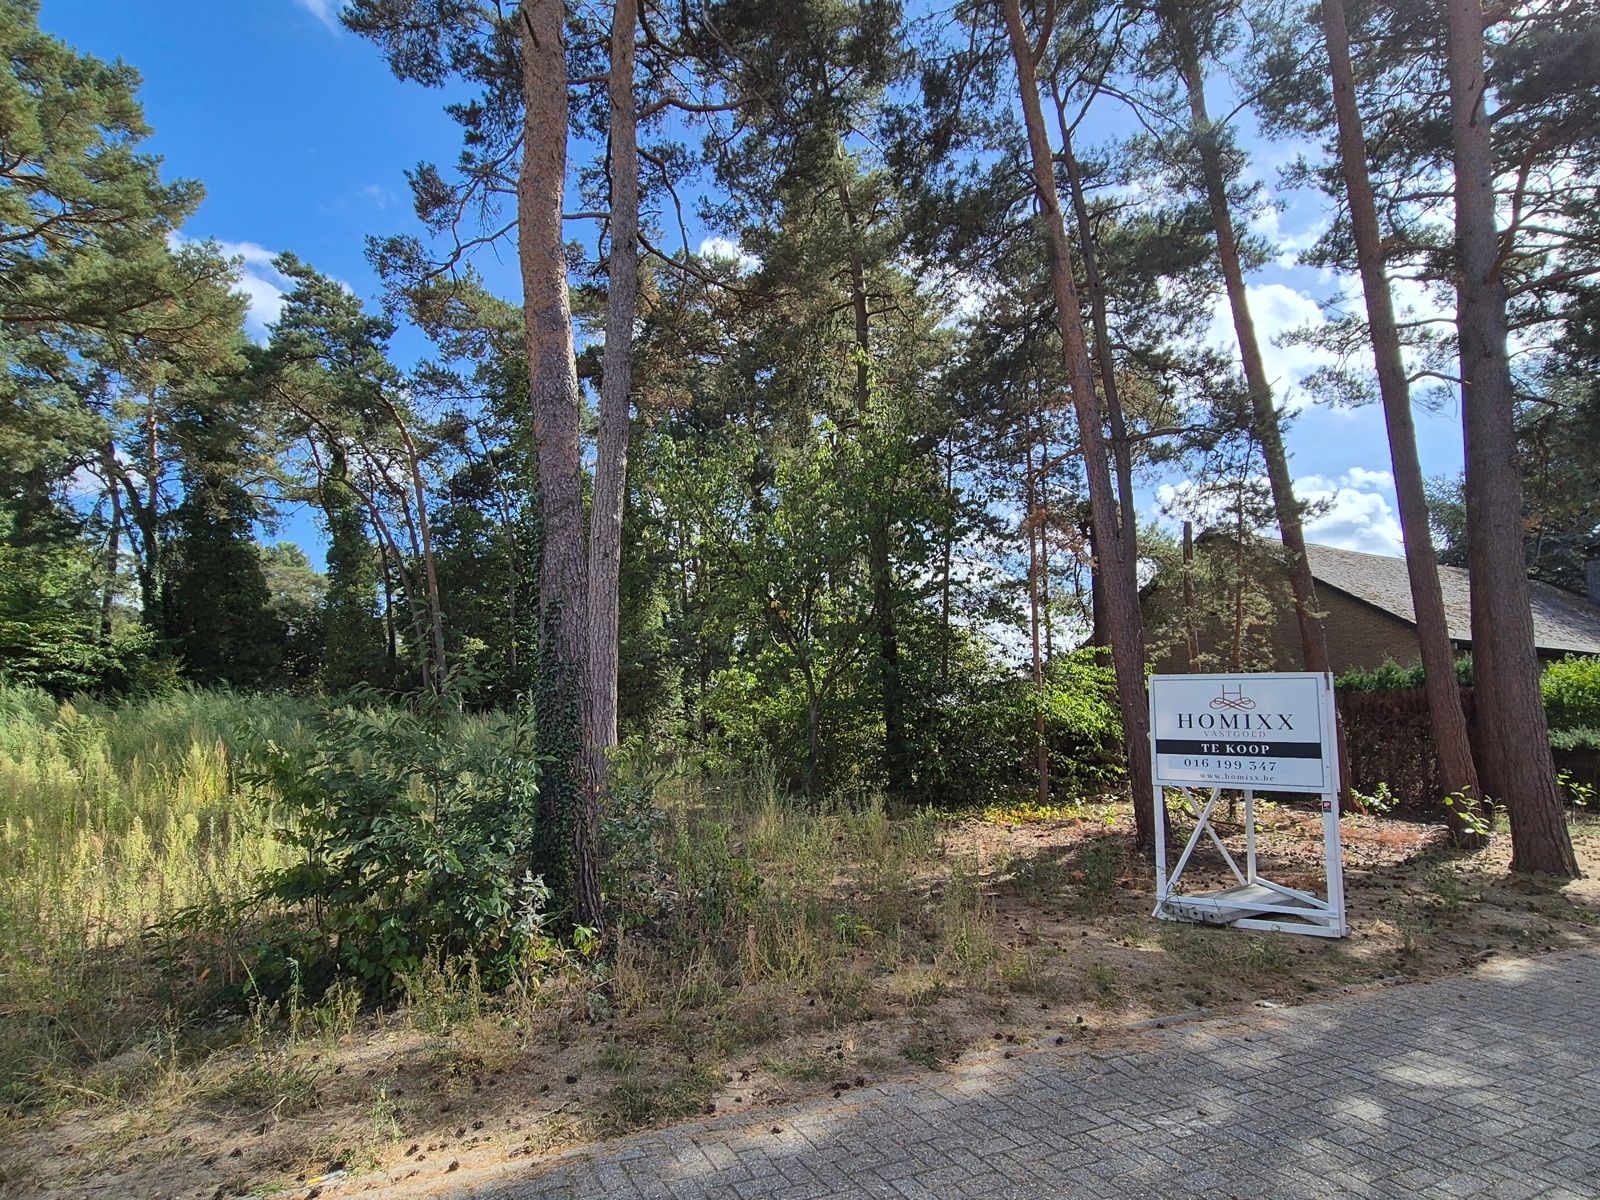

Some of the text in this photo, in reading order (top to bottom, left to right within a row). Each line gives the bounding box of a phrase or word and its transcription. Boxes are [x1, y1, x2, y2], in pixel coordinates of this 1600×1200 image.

[1177, 713, 1294, 731] HOMIXX
[1203, 730, 1266, 739] VASTGOED
[1201, 743, 1270, 755] TE KOOP
[1184, 758, 1277, 772] 016 199 347
[1200, 773, 1275, 782] www.homixx.be
